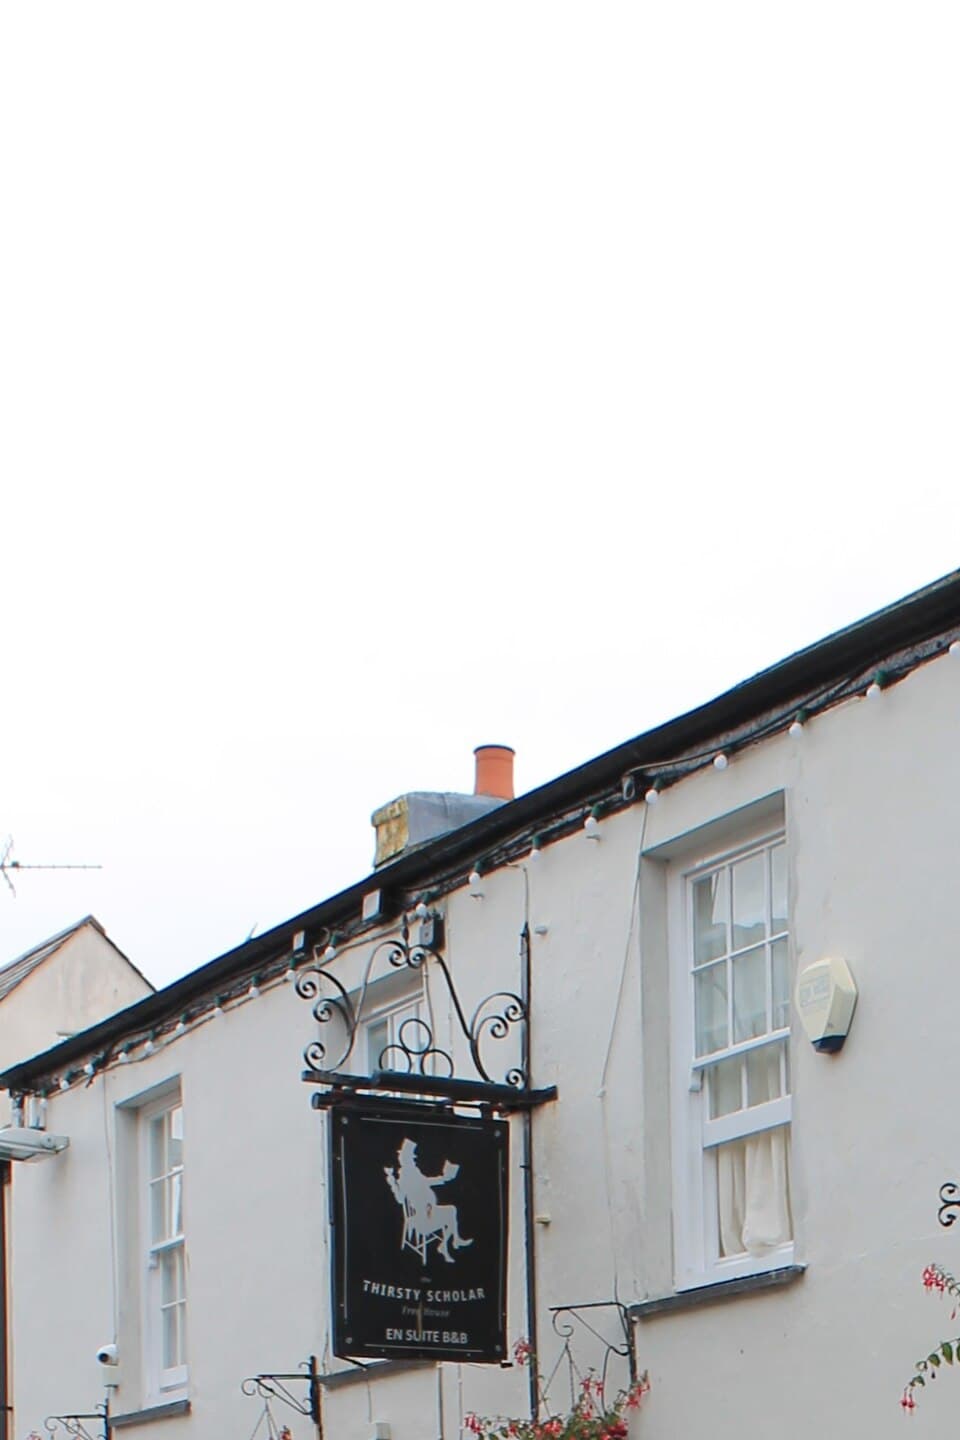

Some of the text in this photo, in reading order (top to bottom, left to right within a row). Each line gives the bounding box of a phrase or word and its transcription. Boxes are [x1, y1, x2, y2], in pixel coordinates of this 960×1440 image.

[363, 1280, 485, 1302] THIRSTY SCHOLAR
[386, 1328, 468, 1344] EN SUITE B&B
